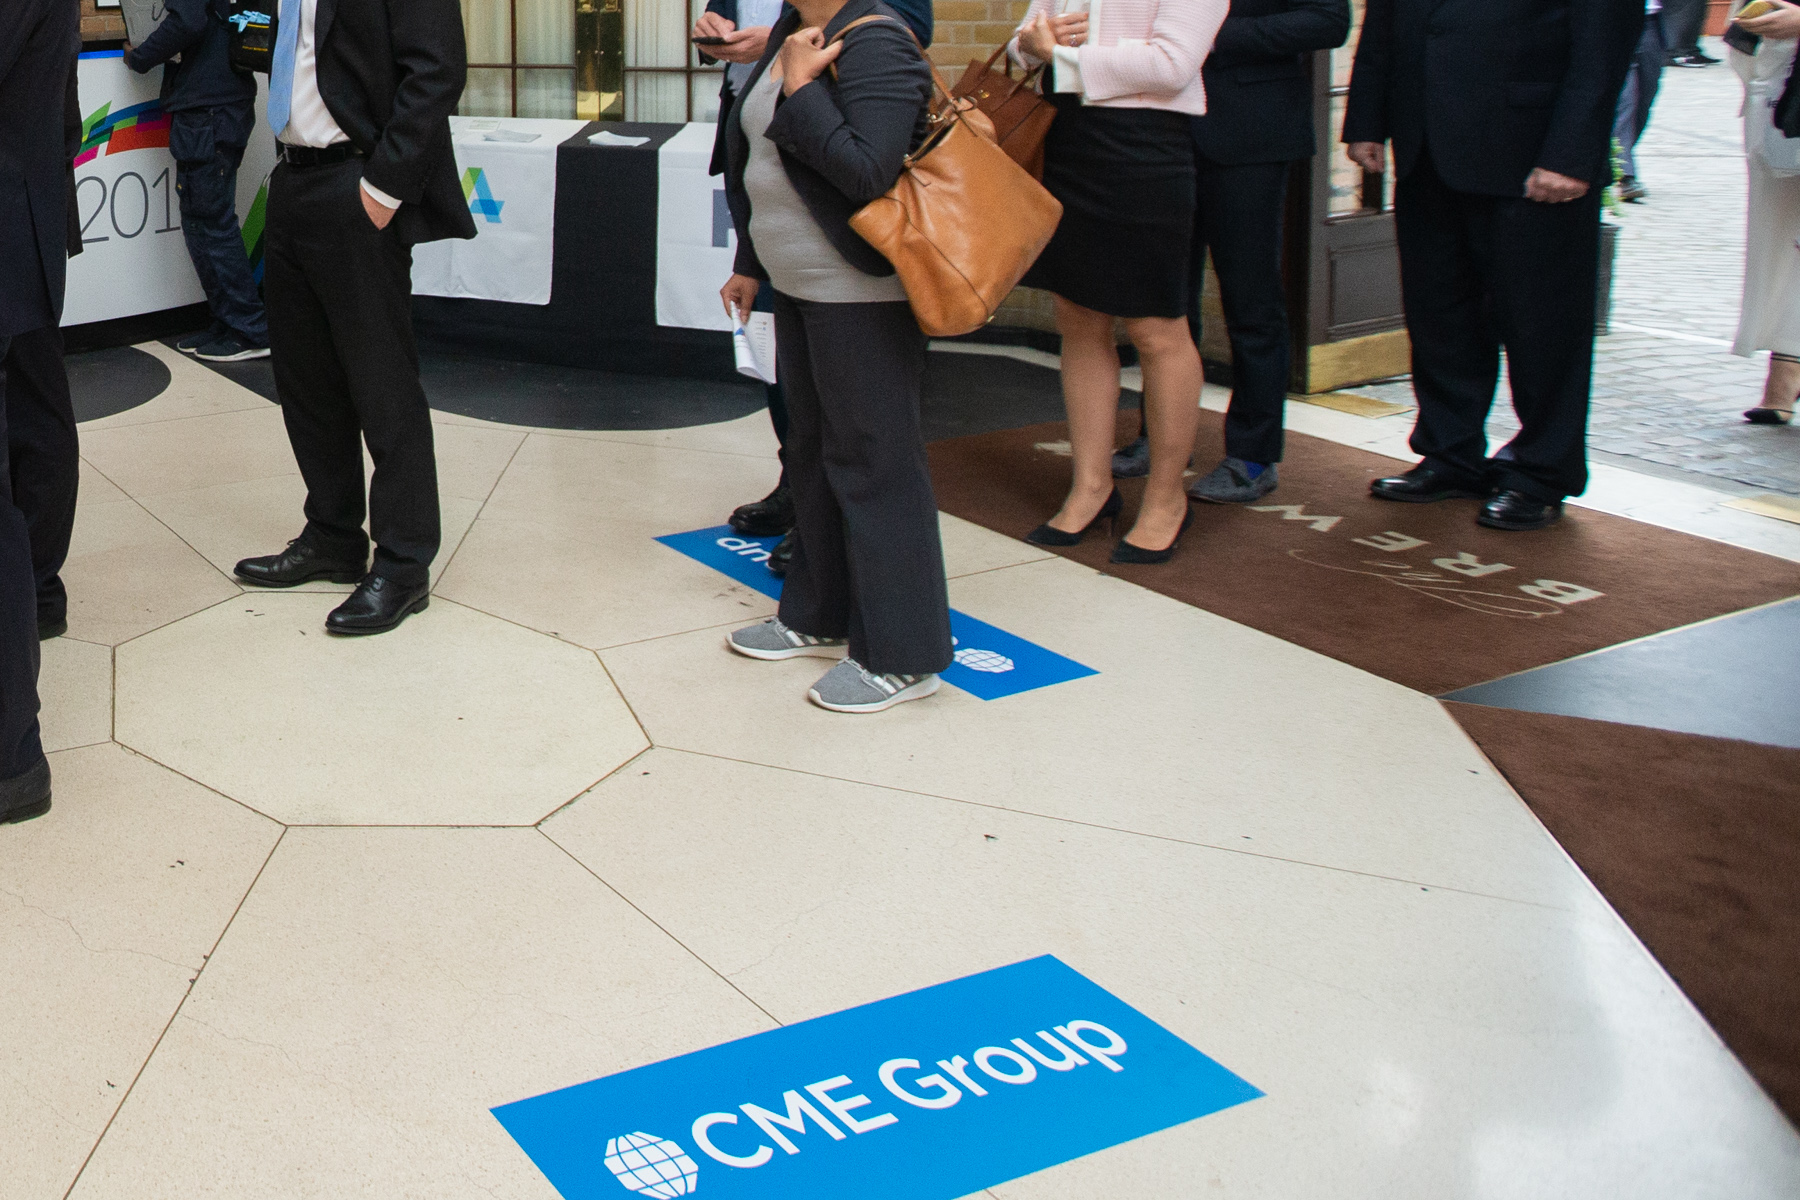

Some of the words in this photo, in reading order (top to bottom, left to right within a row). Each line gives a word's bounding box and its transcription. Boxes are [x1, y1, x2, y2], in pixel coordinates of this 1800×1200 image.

[80, 167, 181, 244] 201
[691, 1074, 899, 1169] CME
[878, 1017, 1128, 1110] Group
